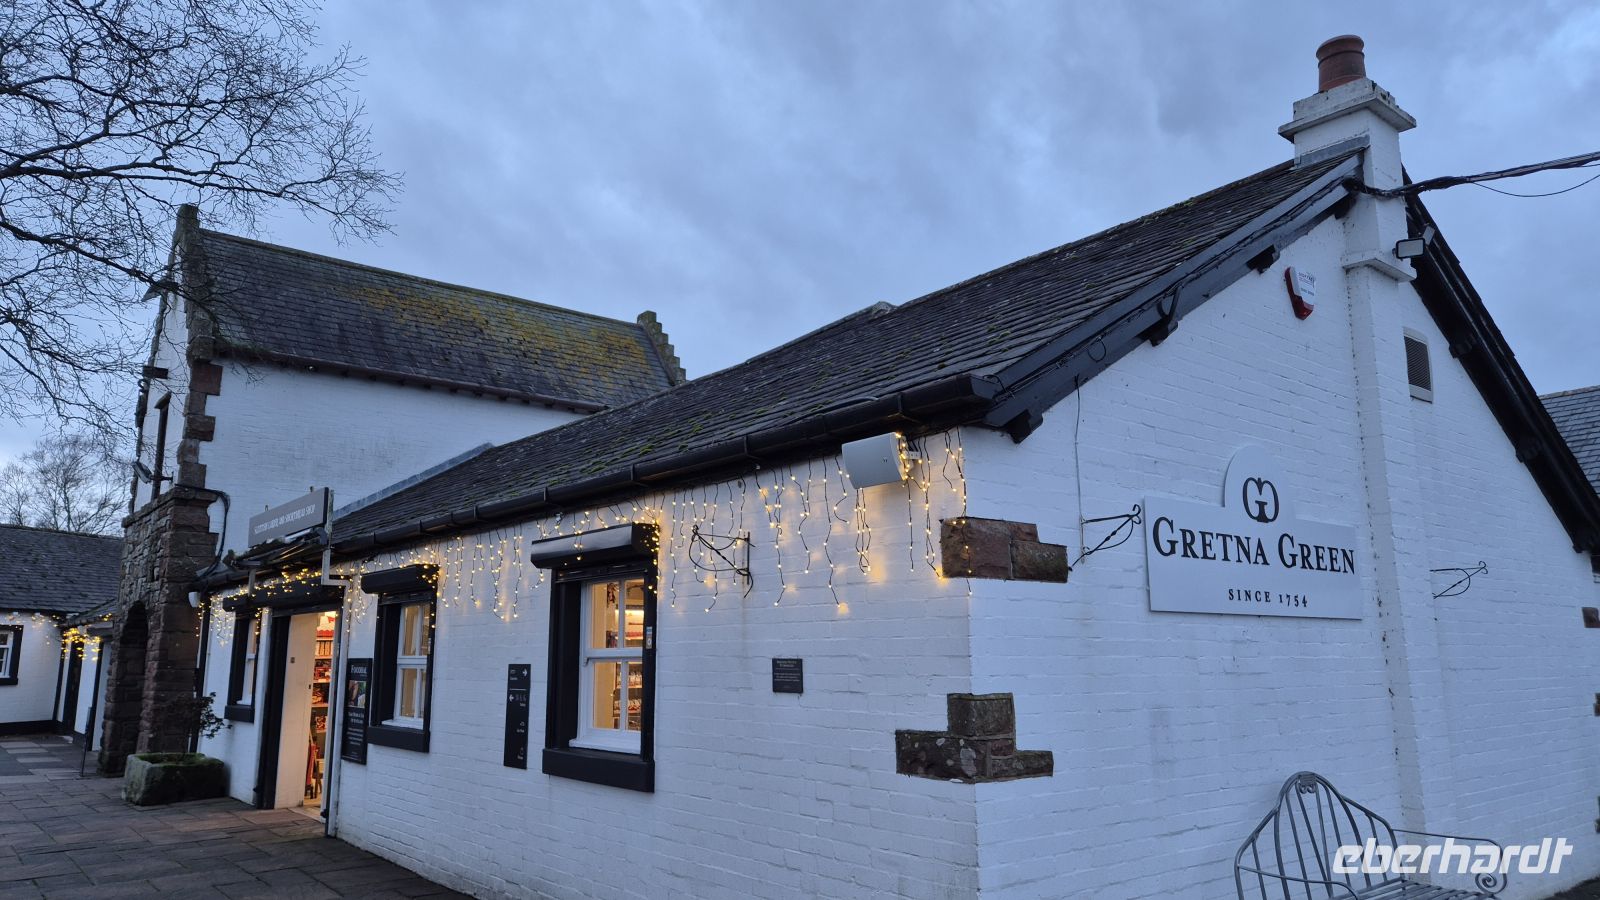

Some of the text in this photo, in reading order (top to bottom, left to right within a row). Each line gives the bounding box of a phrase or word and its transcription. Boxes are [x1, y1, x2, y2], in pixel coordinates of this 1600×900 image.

[1152, 516, 1355, 575] GRETNA GREEN
[1228, 588, 1308, 608] SINCE 1754
